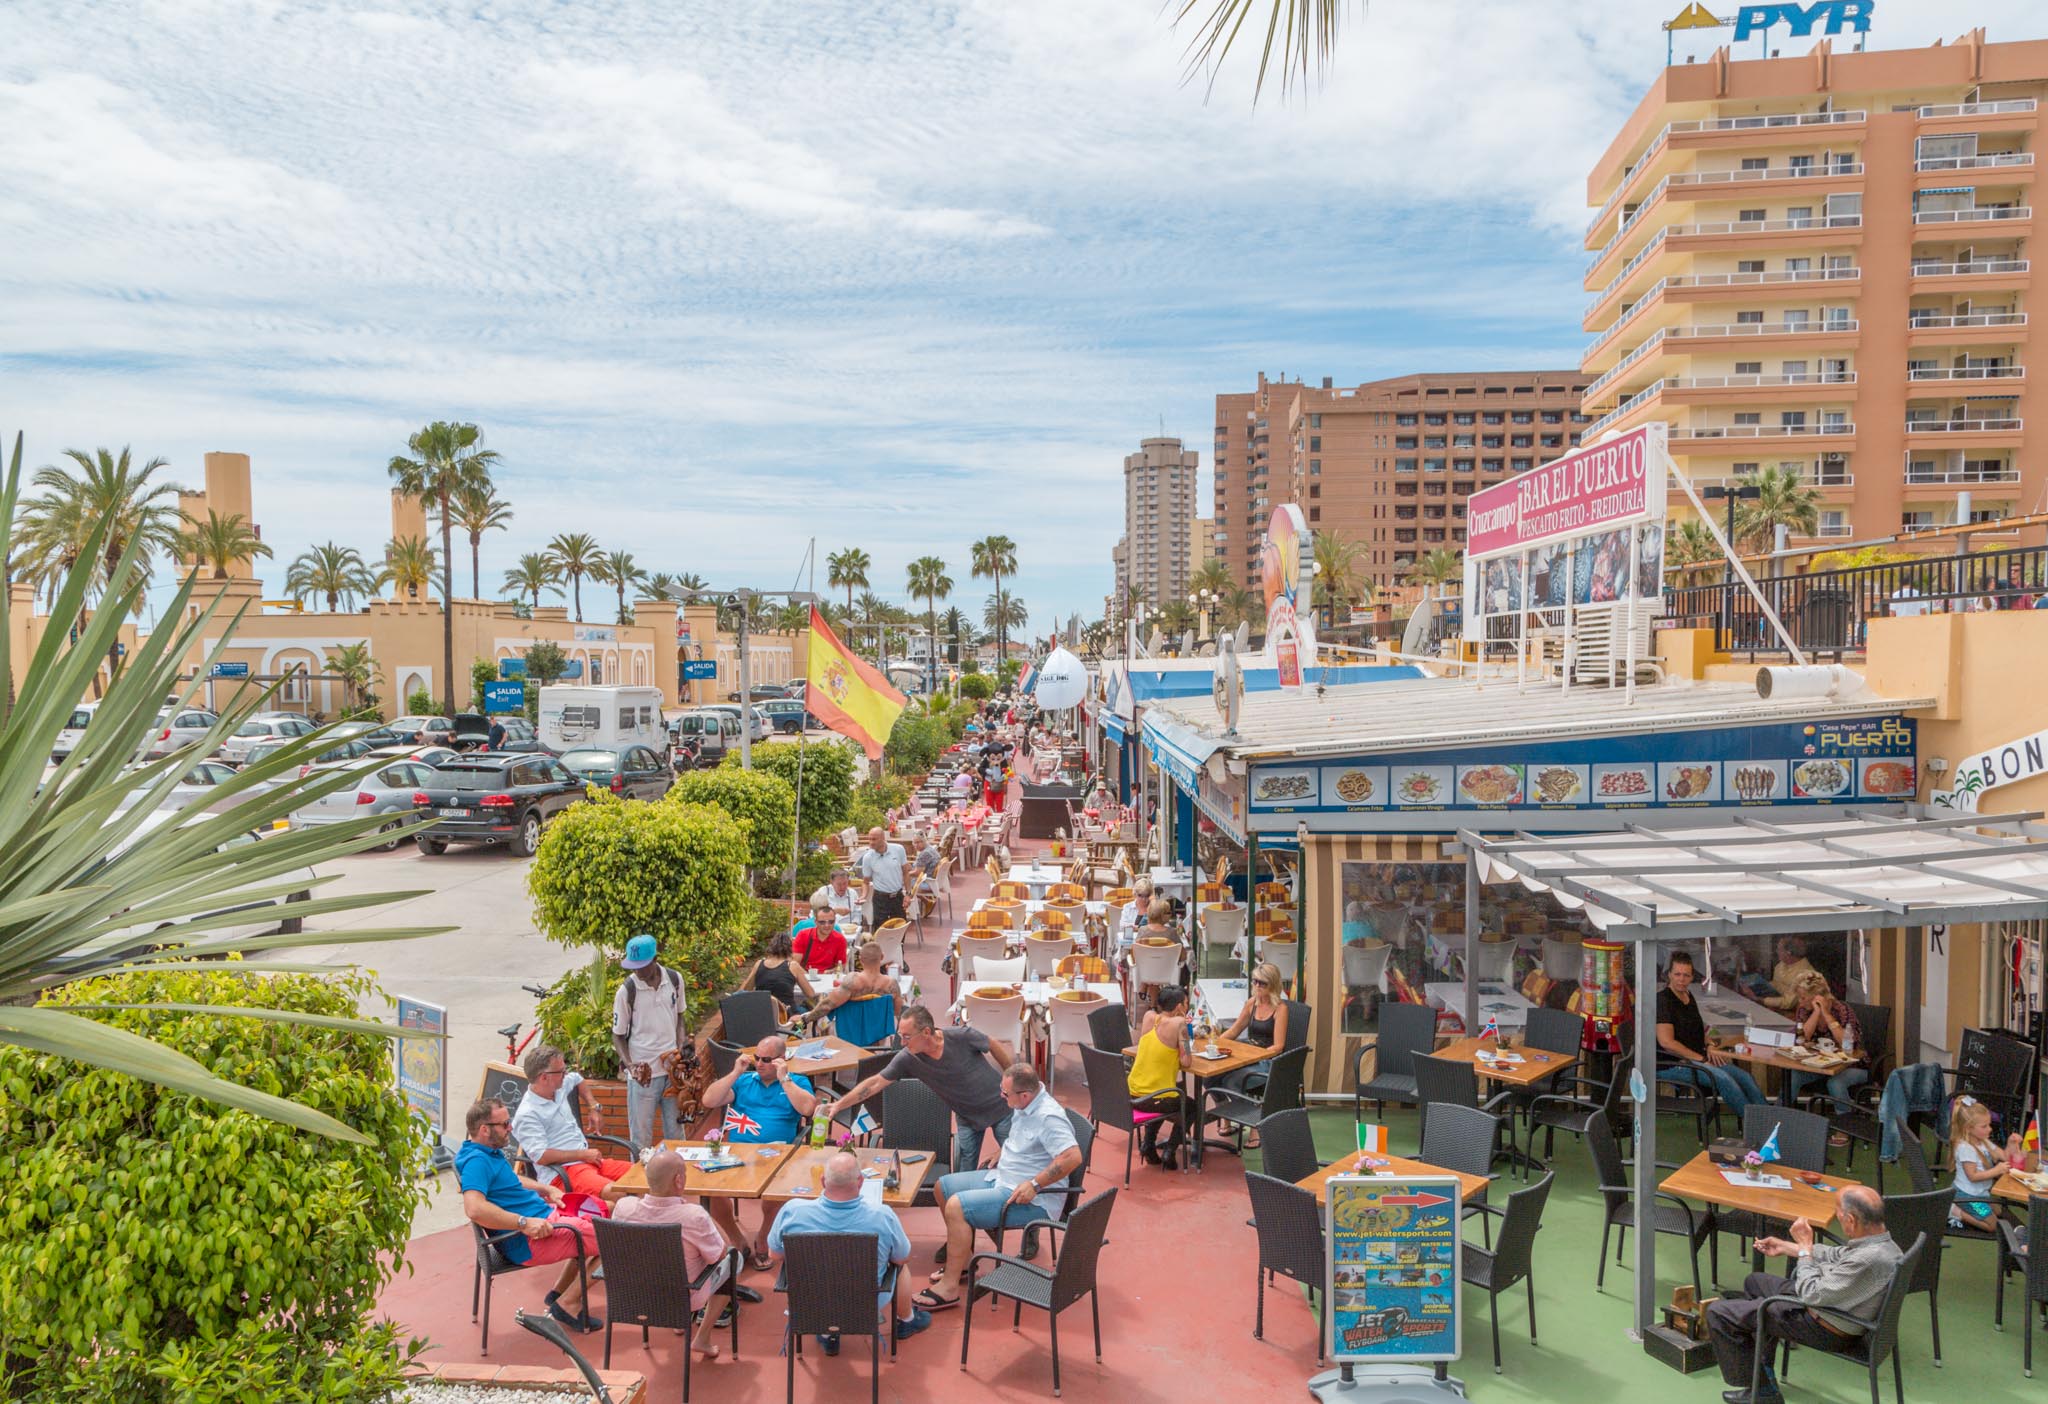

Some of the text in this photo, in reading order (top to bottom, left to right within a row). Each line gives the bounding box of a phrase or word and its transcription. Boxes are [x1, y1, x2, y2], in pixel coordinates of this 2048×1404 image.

[1733, 0, 1875, 42] PYR
[1523, 435, 1646, 513] BAR EL PUERTO
[1522, 512, 1558, 539] PESCAITO
[1559, 504, 1585, 529] FRITO
[1591, 482, 1645, 521] FREIDURÍA
[1470, 503, 1517, 537] Cruzcampo
[496, 687, 522, 695] SALIDA
[1882, 718, 1911, 733] EL
[1821, 732, 1912, 748] PUERTO
[1982, 737, 2044, 787] BON
[1335, 1231, 1452, 1239] www.jet-watersports.com
[1357, 1313, 1386, 1328] JET
[1402, 1323, 1445, 1333] SPORTS
[1344, 1327, 1384, 1341] WATER
[1348, 1335, 1388, 1349] FLYBOARD
